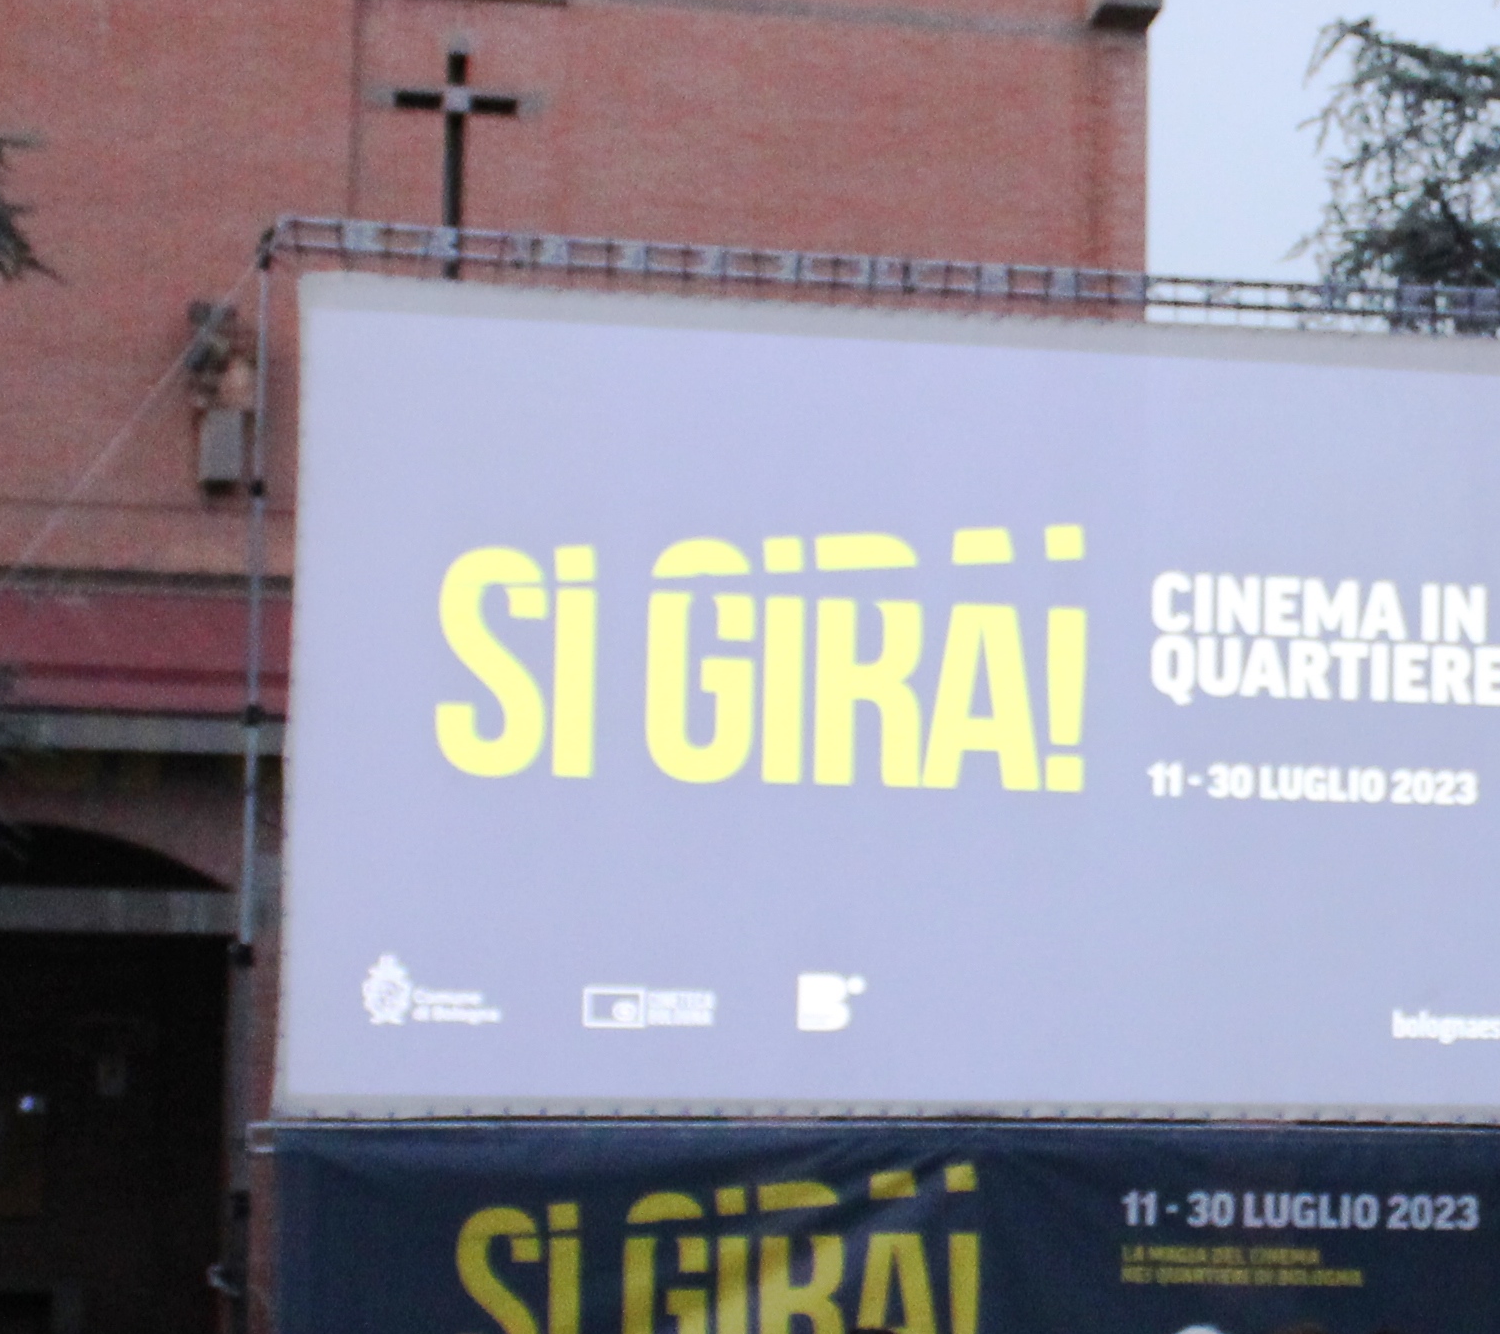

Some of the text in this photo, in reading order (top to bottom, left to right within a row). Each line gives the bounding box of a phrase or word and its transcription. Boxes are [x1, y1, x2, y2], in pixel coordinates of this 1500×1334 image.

[1151, 571, 1487, 644] CINEMA IN
[434, 523, 1086, 794] SI GIRA!
[1147, 762, 1478, 805] 11 - 30 LUGLIO 2023
[1121, 1188, 1480, 1231] 11 - 30 LUGLIO 2023
